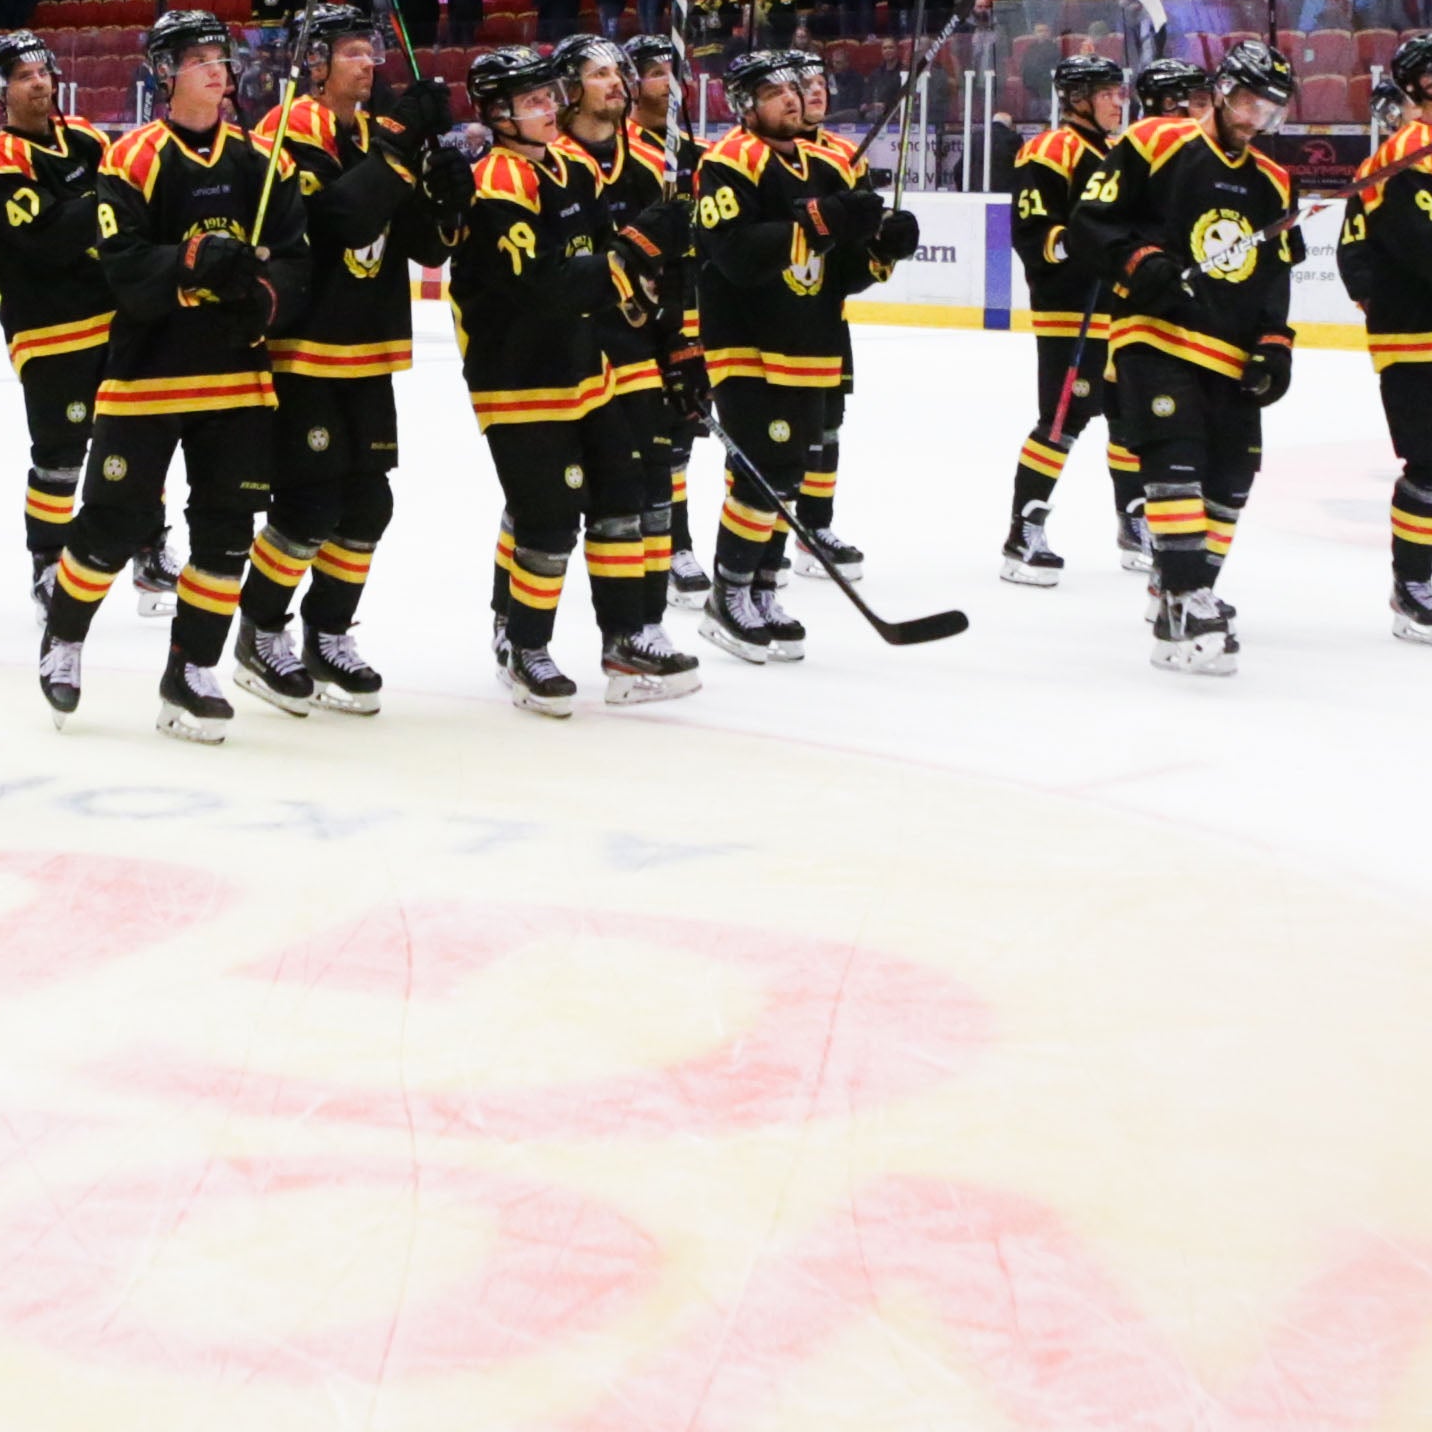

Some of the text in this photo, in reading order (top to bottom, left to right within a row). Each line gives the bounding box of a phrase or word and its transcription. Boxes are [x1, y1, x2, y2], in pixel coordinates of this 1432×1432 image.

[700, 185, 740, 230] 88
[1081, 170, 1120, 203] 56
[497, 221, 537, 276] 19
